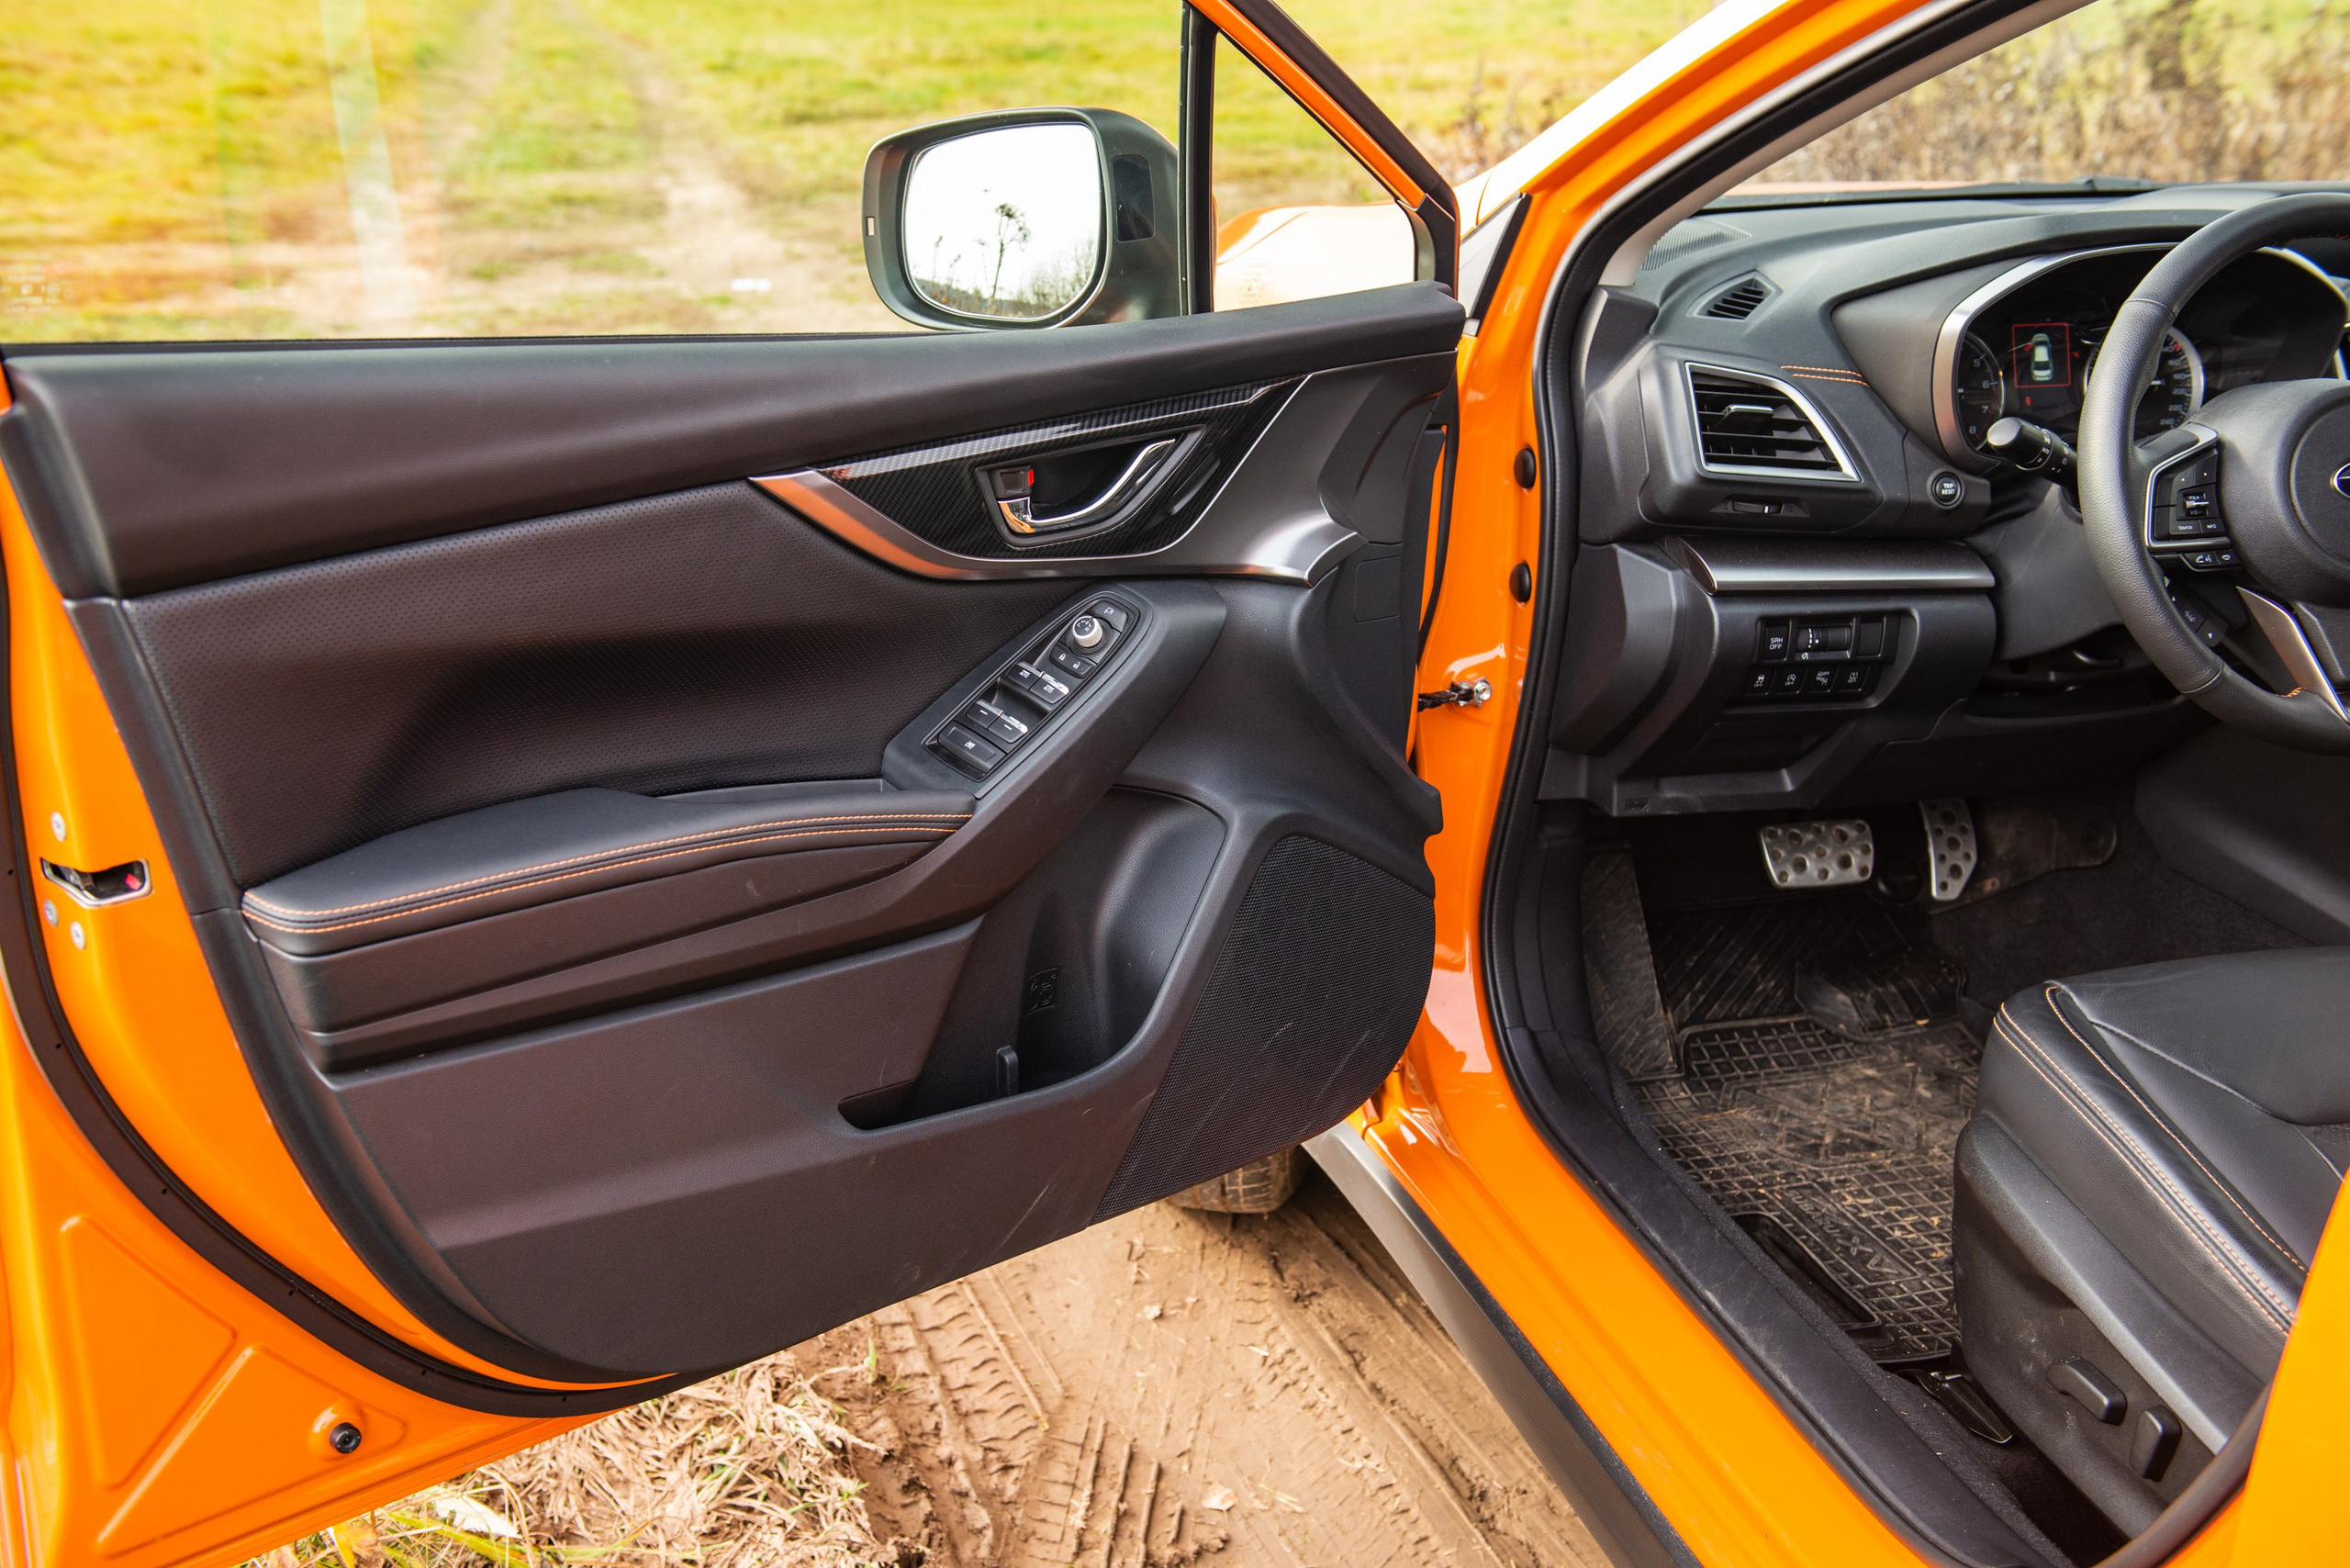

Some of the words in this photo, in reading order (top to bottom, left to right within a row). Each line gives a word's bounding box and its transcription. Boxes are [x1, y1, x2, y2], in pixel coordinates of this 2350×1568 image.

[1974, 359, 1981, 367] 5
[1982, 380, 1990, 388] 6
[1969, 426, 1976, 434] 8
